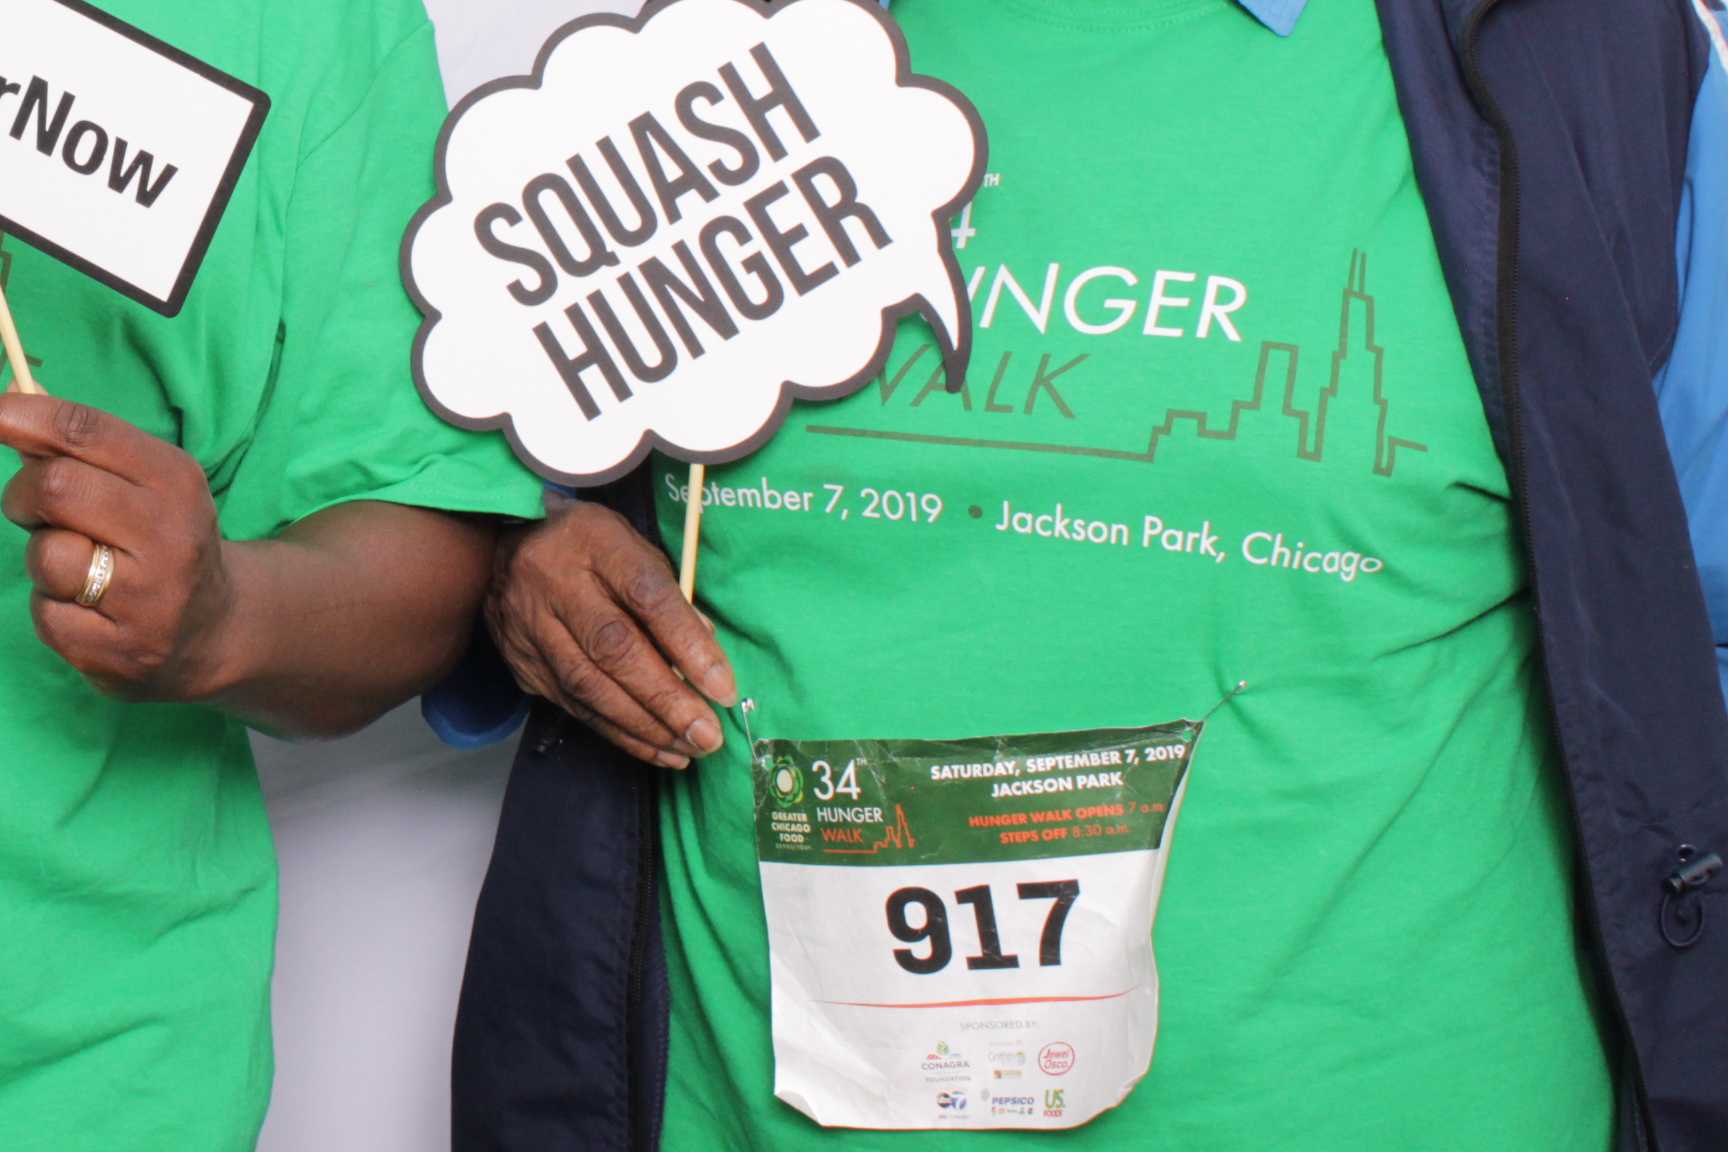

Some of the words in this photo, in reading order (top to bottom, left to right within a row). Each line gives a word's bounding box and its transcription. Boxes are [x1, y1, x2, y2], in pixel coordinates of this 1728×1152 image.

[473, 41, 821, 307] SQUASH
[531, 154, 893, 423] HUNGER
[967, 262, 1247, 342] NGER
[822, 484, 849, 521] 7,
[861, 488, 942, 524] 2019
[996, 501, 1129, 546] Jackson
[1143, 516, 1225, 563] Park,
[1241, 531, 1383, 581] Chicago
[930, 761, 1021, 780] SATURDAY,
[1026, 750, 1121, 773] SEPTEMBER
[1125, 749, 1139, 765] 7,
[1145, 745, 1186, 762] 2019
[991, 777, 1073, 798] JACKSON
[1076, 772, 1125, 789] PARK
[772, 811, 808, 822] GREATER
[816, 807, 884, 823] HUNGER
[968, 813, 1028, 828] HUNGER
[1030, 809, 1073, 824] WALK
[1075, 804, 1124, 819] OPENS
[1128, 801, 1137, 814] 7
[771, 822, 811, 833] CHICAGO
[821, 828, 865, 843] WALK
[1000, 830, 1039, 844] STEPS
[1041, 827, 1069, 841] OFF
[1072, 824, 1102, 838] 8:30
[885, 879, 1080, 975] 917
[960, 1021, 1022, 1031] SPONSORED
[1043, 1048, 1069, 1059] Jewel
[921, 1060, 970, 1070] CONAGRA
[991, 1097, 1034, 1105] PEPSICO
